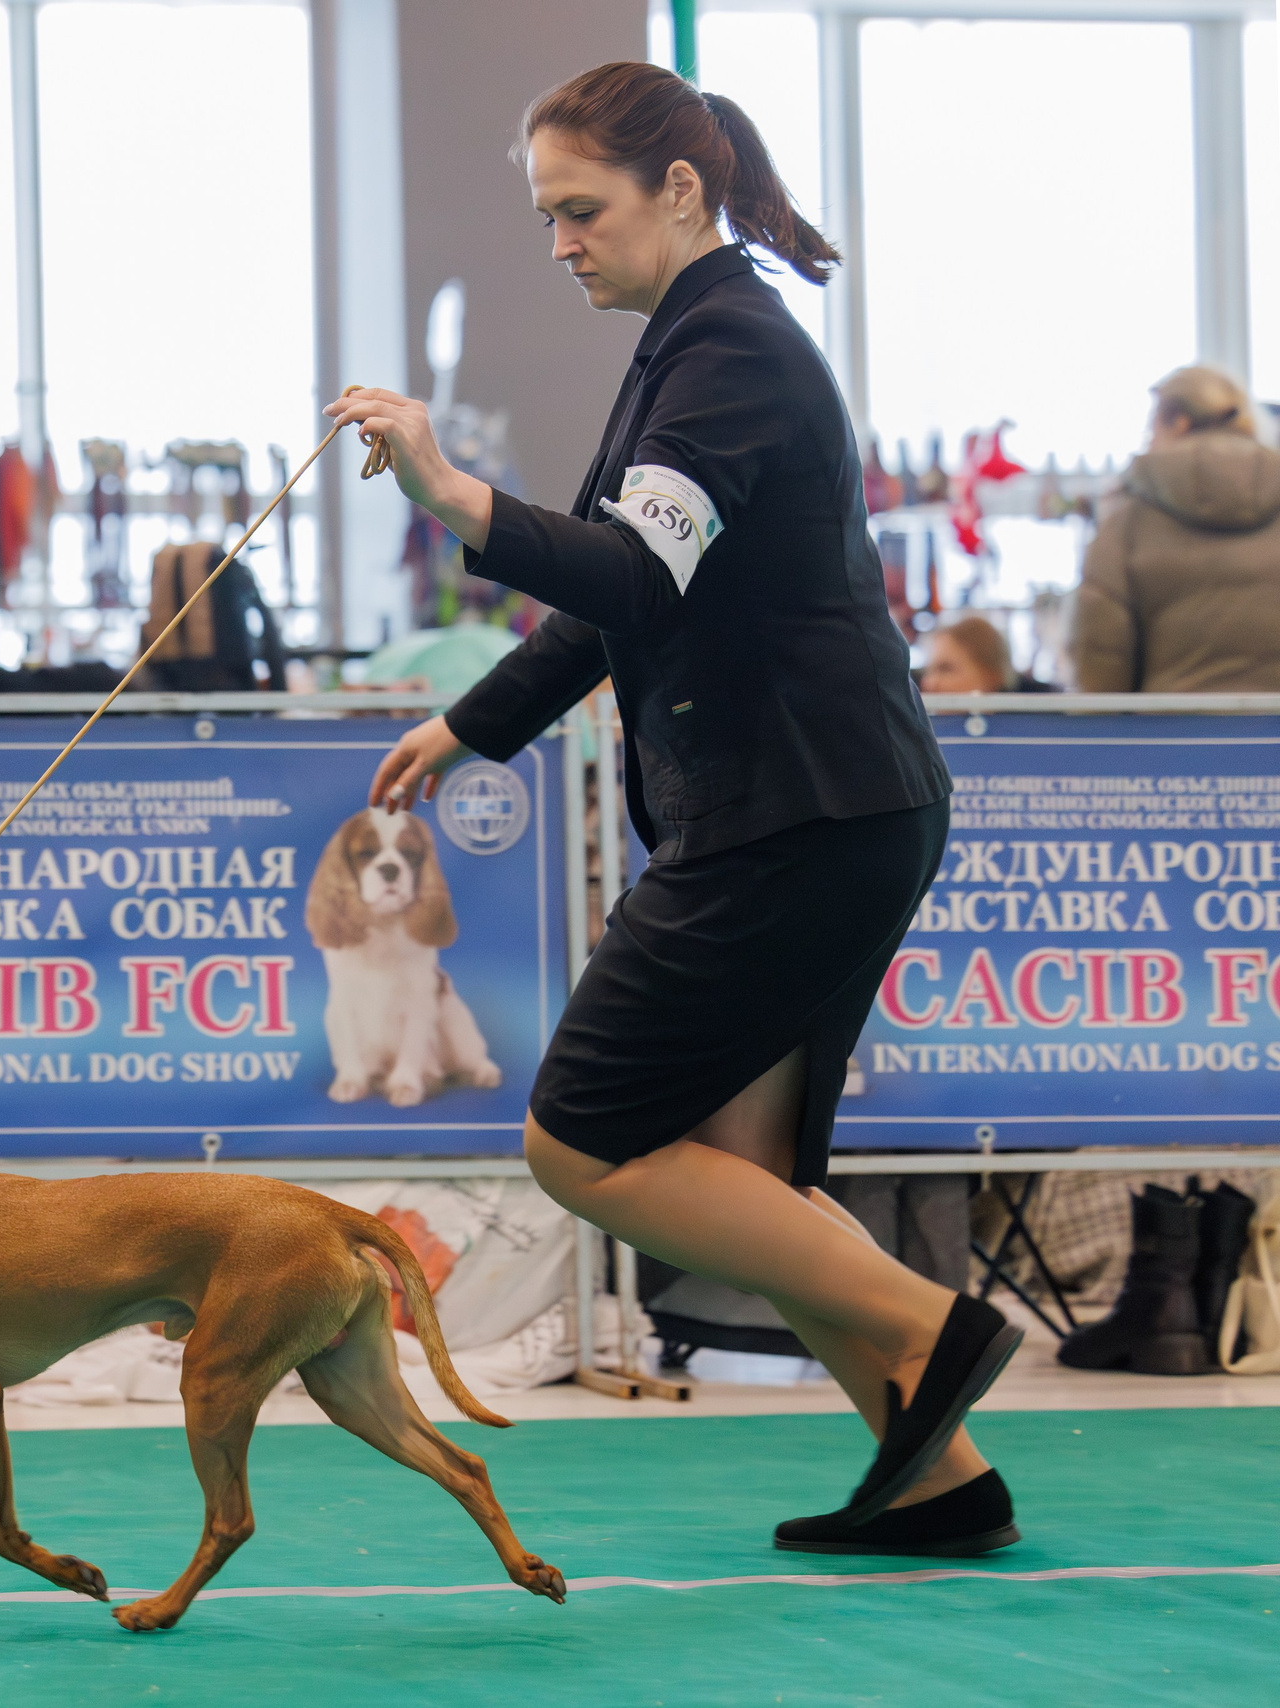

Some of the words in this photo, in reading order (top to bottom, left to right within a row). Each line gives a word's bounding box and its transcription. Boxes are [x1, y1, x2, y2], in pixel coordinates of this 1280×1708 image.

[641, 498, 693, 541] 659
[141, 817, 211, 835] UNION
[1086, 812, 1222, 829] CINOLOGICAL
[110, 896, 288, 940] СОБАК
[907, 890, 1170, 932] ЫСТАВКА
[120, 954, 296, 1038] FCI
[877, 946, 1187, 1029] CACIB
[1204, 948, 1280, 1028] F
[89, 1052, 173, 1083] DOG
[181, 1051, 301, 1082] SHOW
[872, 1043, 1170, 1073] INTERNATIONAL
[1177, 1042, 1259, 1072] DOG
